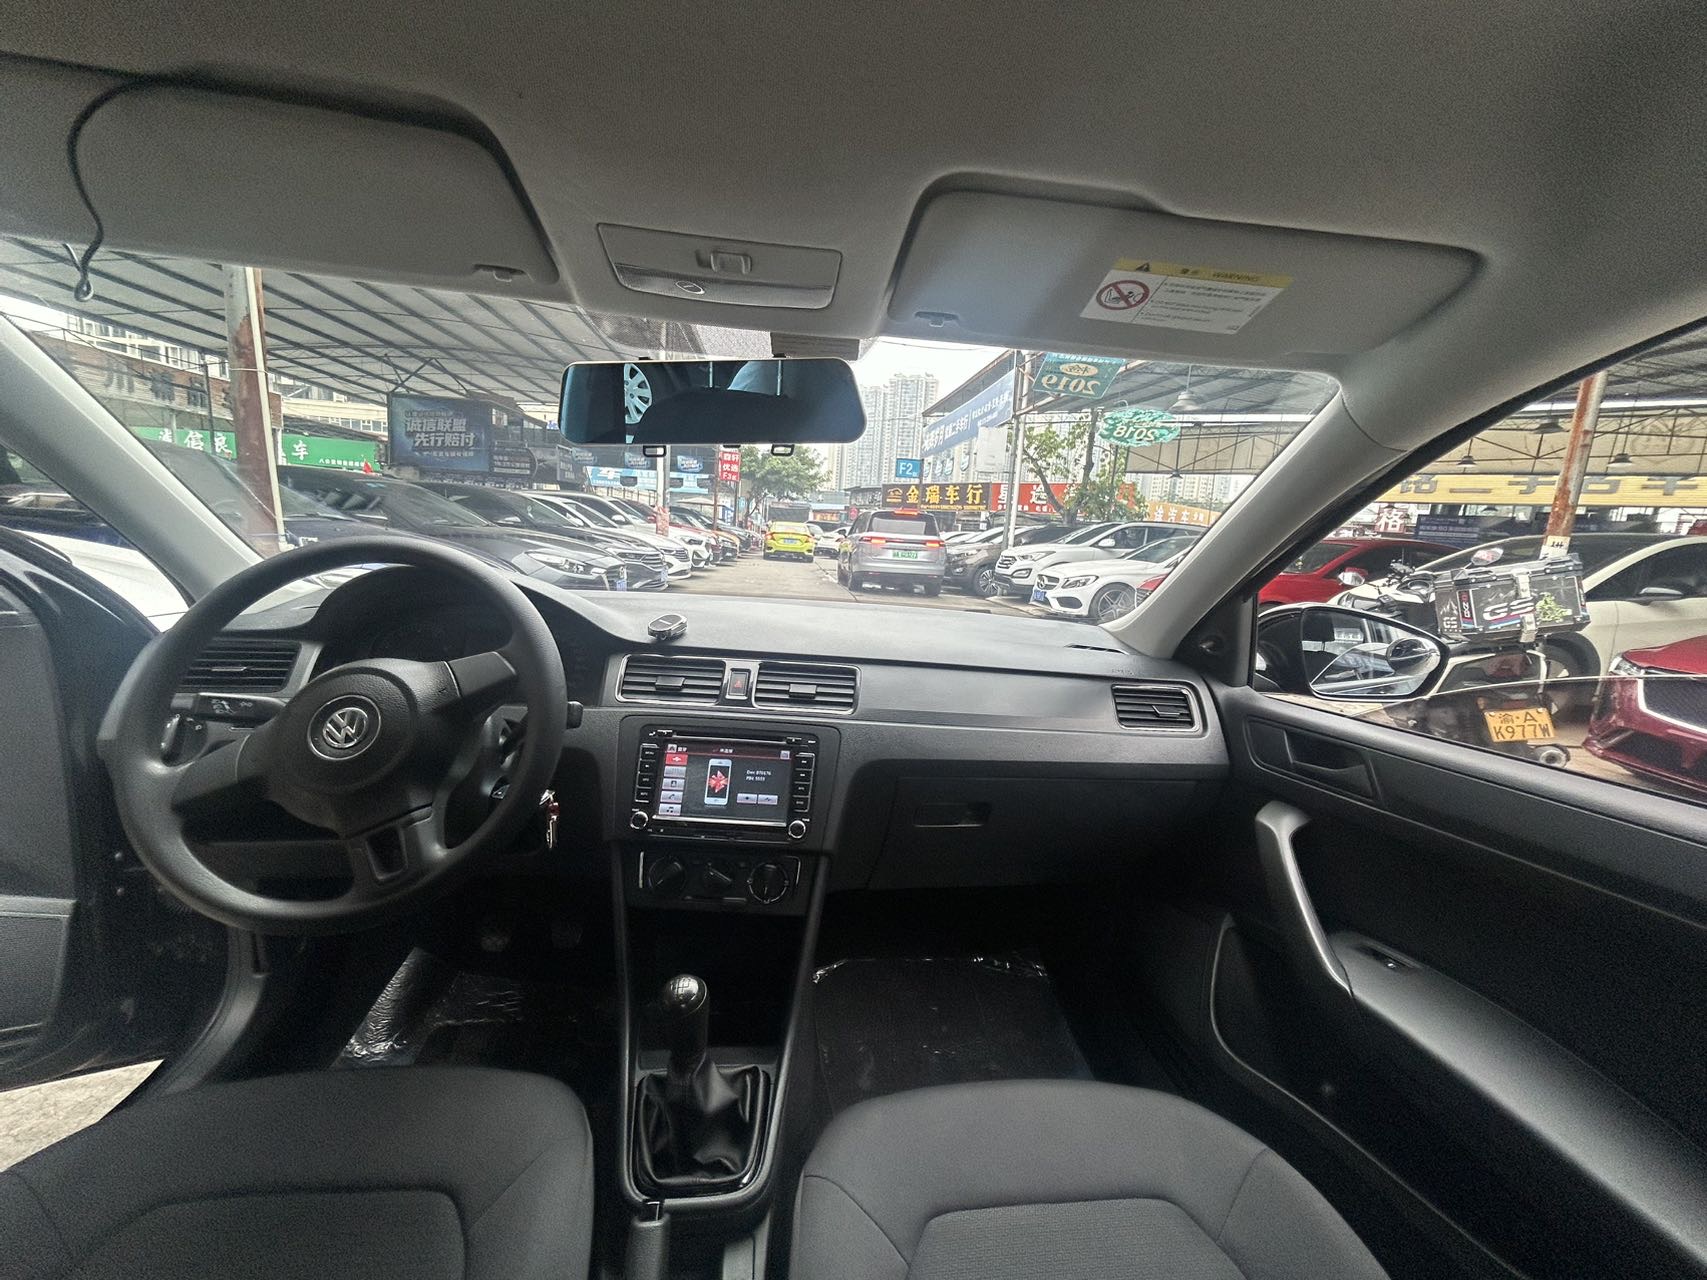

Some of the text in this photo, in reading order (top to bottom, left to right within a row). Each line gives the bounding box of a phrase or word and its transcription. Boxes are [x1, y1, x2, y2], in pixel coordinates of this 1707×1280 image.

[406, 418, 467, 432] 诚信联盟
[414, 432, 476, 447] 先行赔付
[906, 484, 983, 505] 金瑞车行
[1493, 723, 1551, 740] K977W
